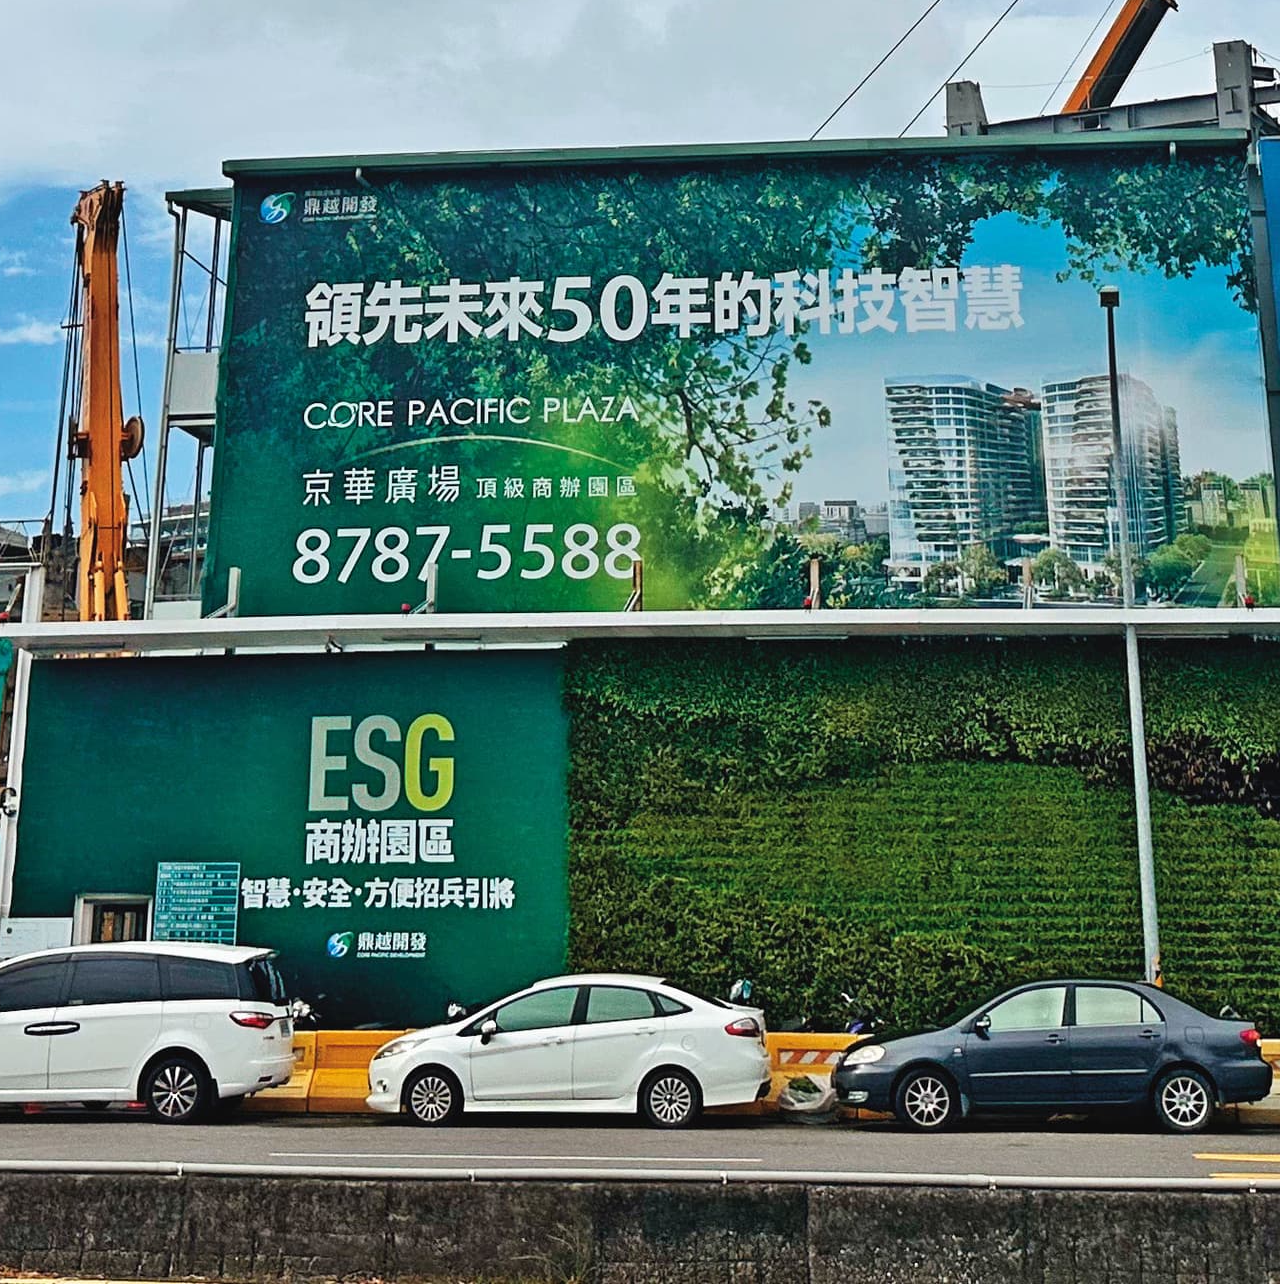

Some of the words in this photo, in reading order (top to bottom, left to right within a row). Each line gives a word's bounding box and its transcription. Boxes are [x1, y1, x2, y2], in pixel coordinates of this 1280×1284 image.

[304, 196, 378, 216] 鼎越開發
[305, 264, 1025, 348] 領先未來50年的科技智慧
[304, 401, 393, 430] CORE
[407, 397, 531, 427] PACIFIC
[543, 395, 639, 423] PLAZA
[302, 466, 462, 507] 京華廣場
[475, 475, 638, 499] 頂級商辦園區
[292, 523, 642, 584] 8787-5588
[308, 713, 455, 811] ESG
[305, 818, 455, 865] 商辦園區
[357, 931, 427, 951] 鼎越開發
